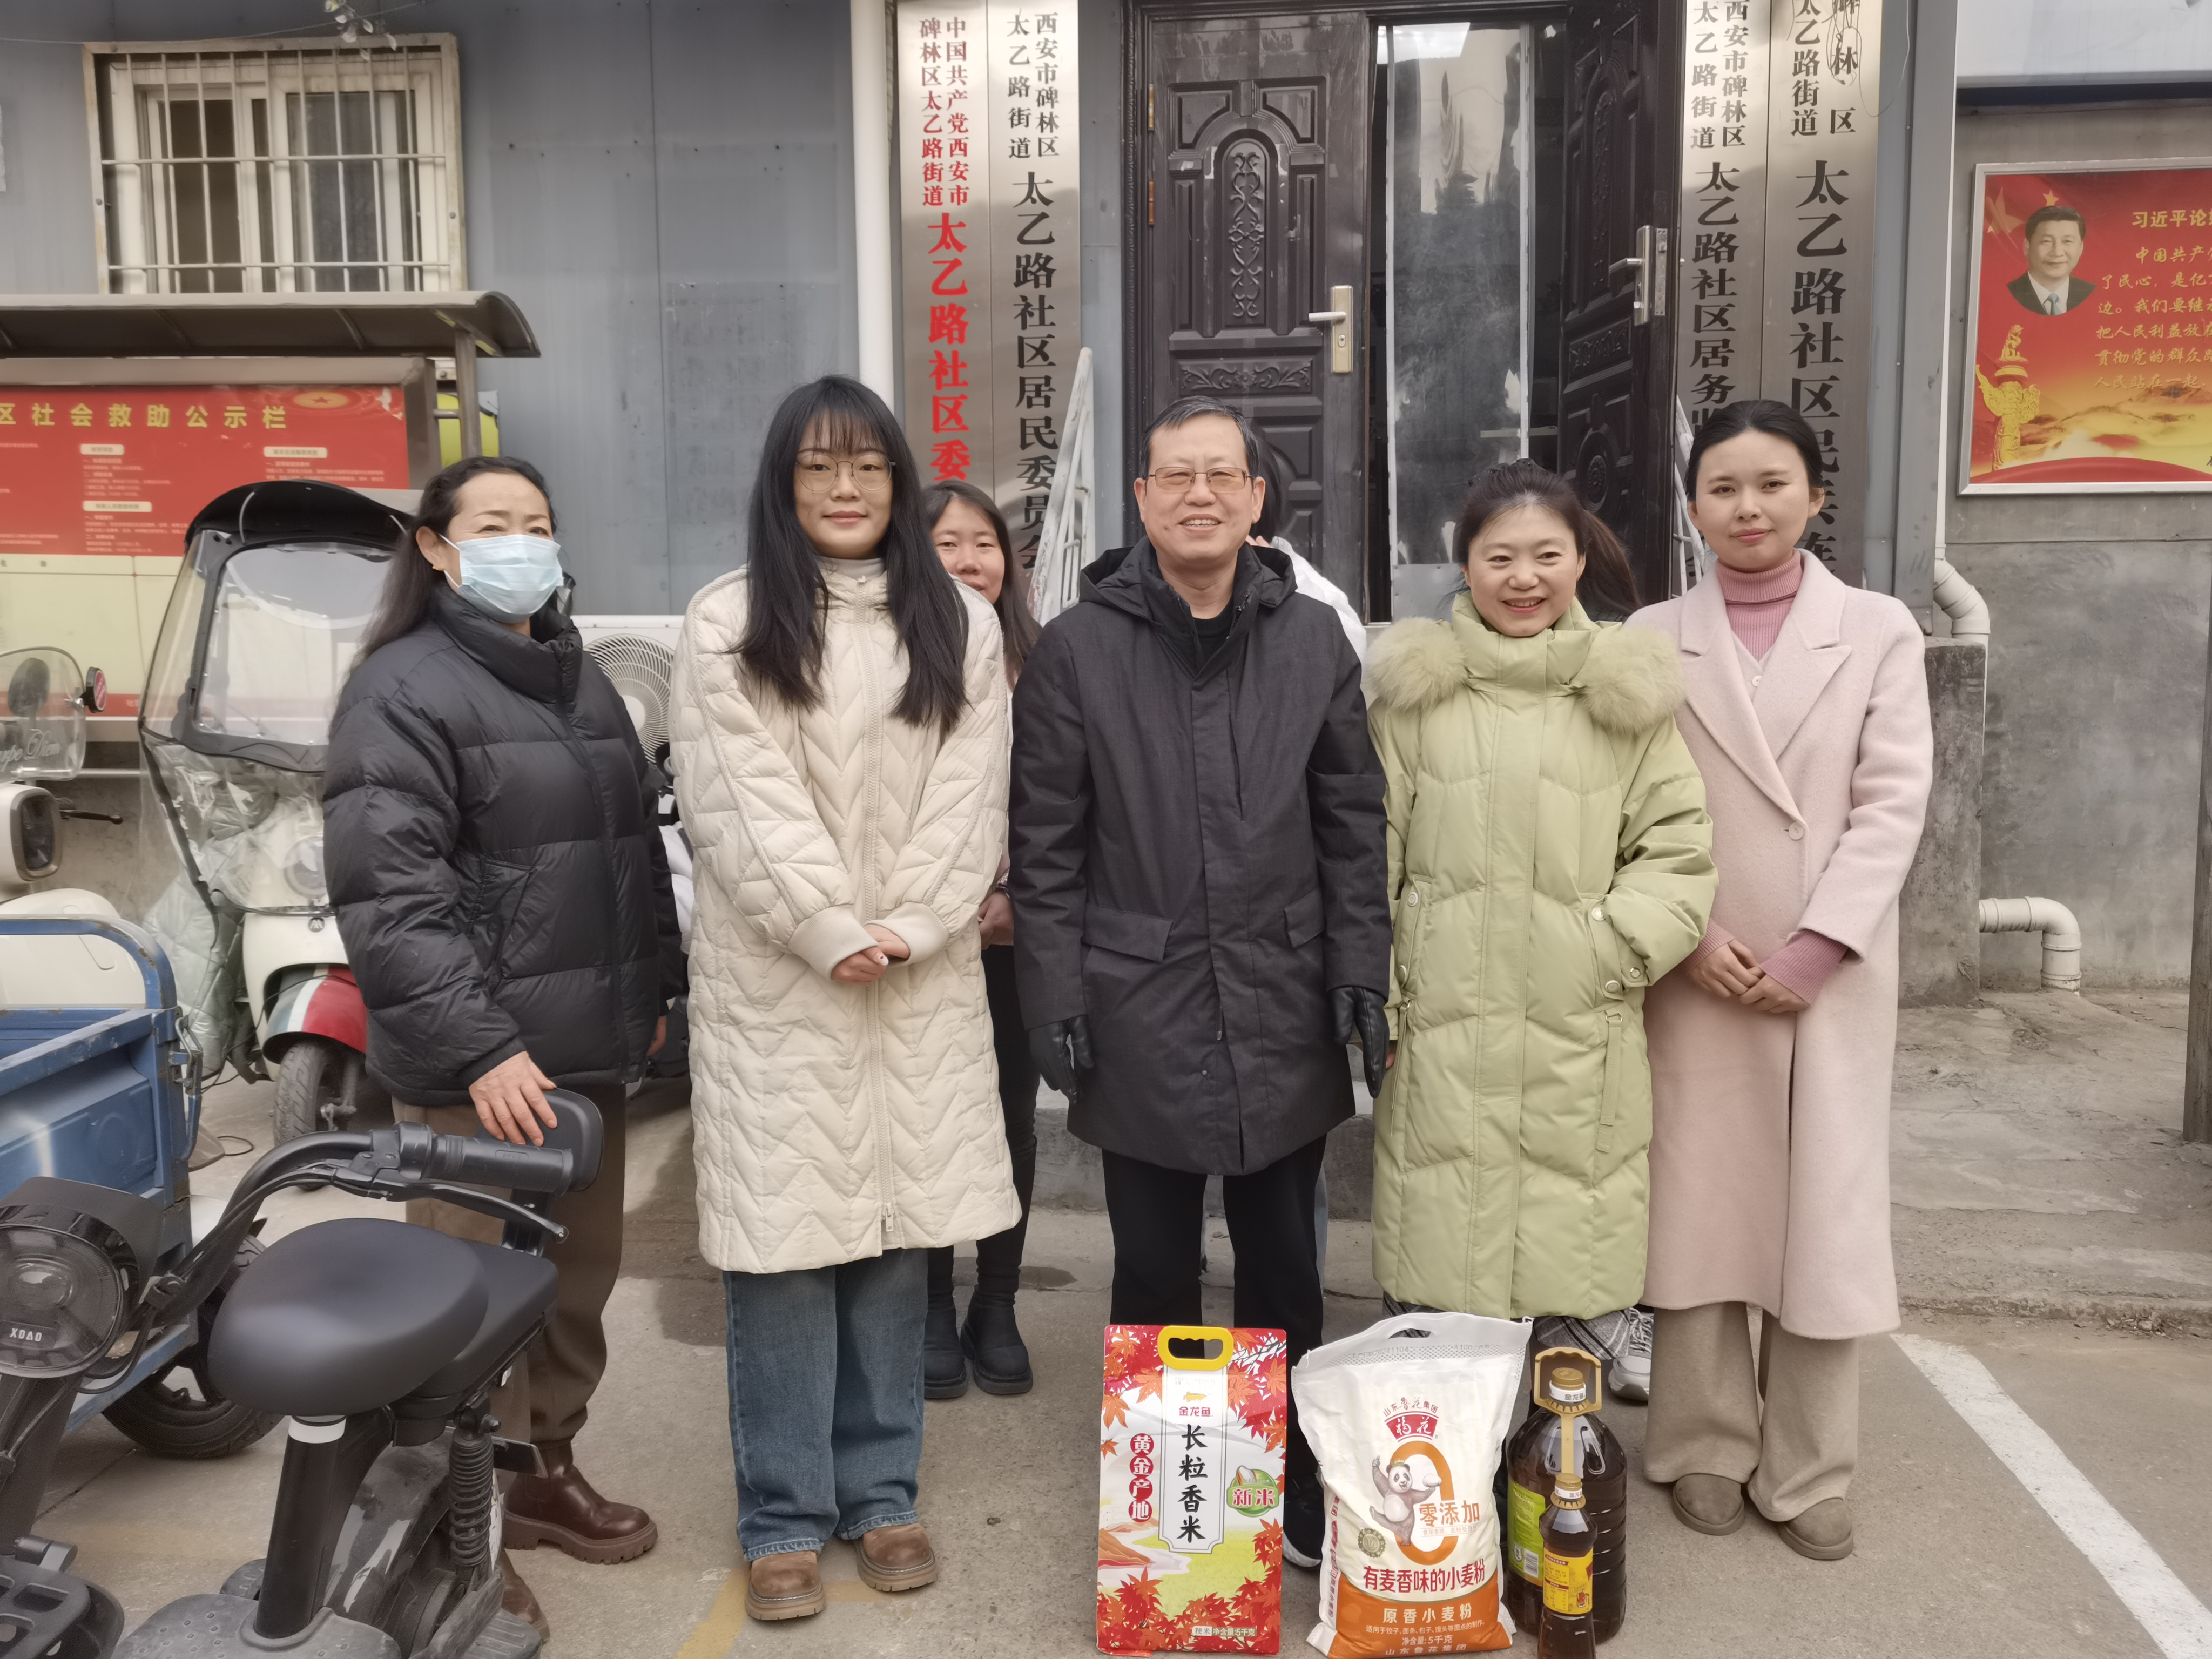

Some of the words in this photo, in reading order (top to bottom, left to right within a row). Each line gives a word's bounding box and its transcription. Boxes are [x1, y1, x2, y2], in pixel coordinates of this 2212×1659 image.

[1007, 14, 1031, 158] 太乙路街道
[1034, 12, 1060, 157] 西安市碑林区
[1690, 1, 1719, 149] 太乙路街道
[1721, 0, 1750, 147] 西安市碑林区
[919, 17, 943, 206] 碑林区太乙路街道
[946, 16, 970, 206] 中国共产党西安市
[2132, 208, 2212, 228] 习近平论
[2102, 272, 2212, 290] 了民心，是亿
[0, 403, 287, 429] 区社会救助公示栏
[1179, 1406, 1210, 1417] 金龙鱼
[1131, 1435, 1151, 1520] 黄金产地
[1176, 1424, 1208, 1543] 长粒香米
[1232, 1488, 1275, 1507] 新米
[1419, 1500, 1480, 1527] 零添加
[1363, 1559, 1486, 1593] 有麦香味的小麦粉
[1383, 1602, 1472, 1624] 原香小麦粉
[1385, 1644, 1467, 1655] 山东鲁花集团
